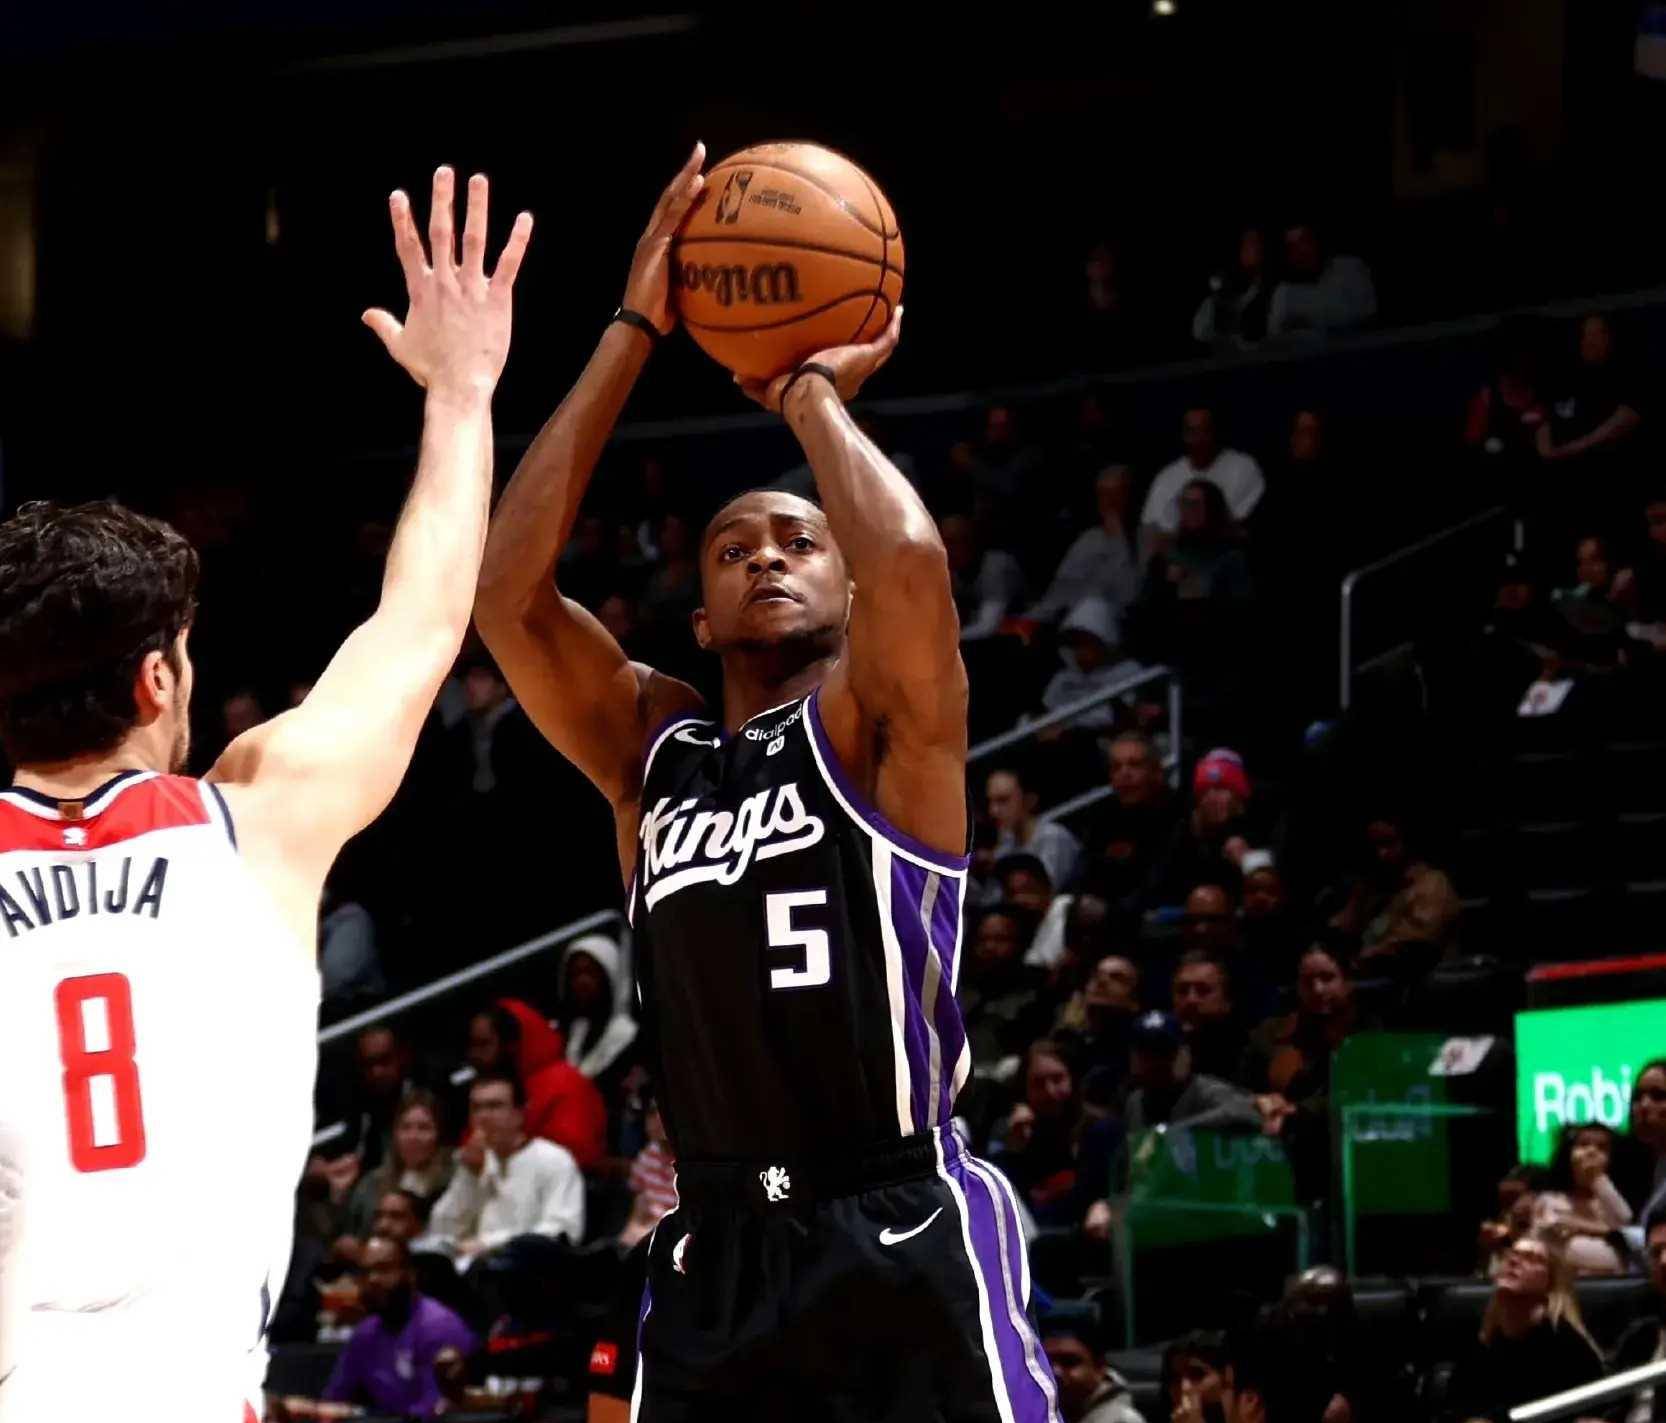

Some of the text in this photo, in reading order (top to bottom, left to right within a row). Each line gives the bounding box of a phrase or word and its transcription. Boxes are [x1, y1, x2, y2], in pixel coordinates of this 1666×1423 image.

[682, 262, 801, 307] Wilso
[744, 703, 802, 741] dialpad
[640, 783, 825, 912] Kings
[0, 857, 169, 938] AVDIJA
[766, 889, 831, 989] 5
[53, 971, 147, 1173] 8
[1534, 1064, 1632, 1134] Robi
